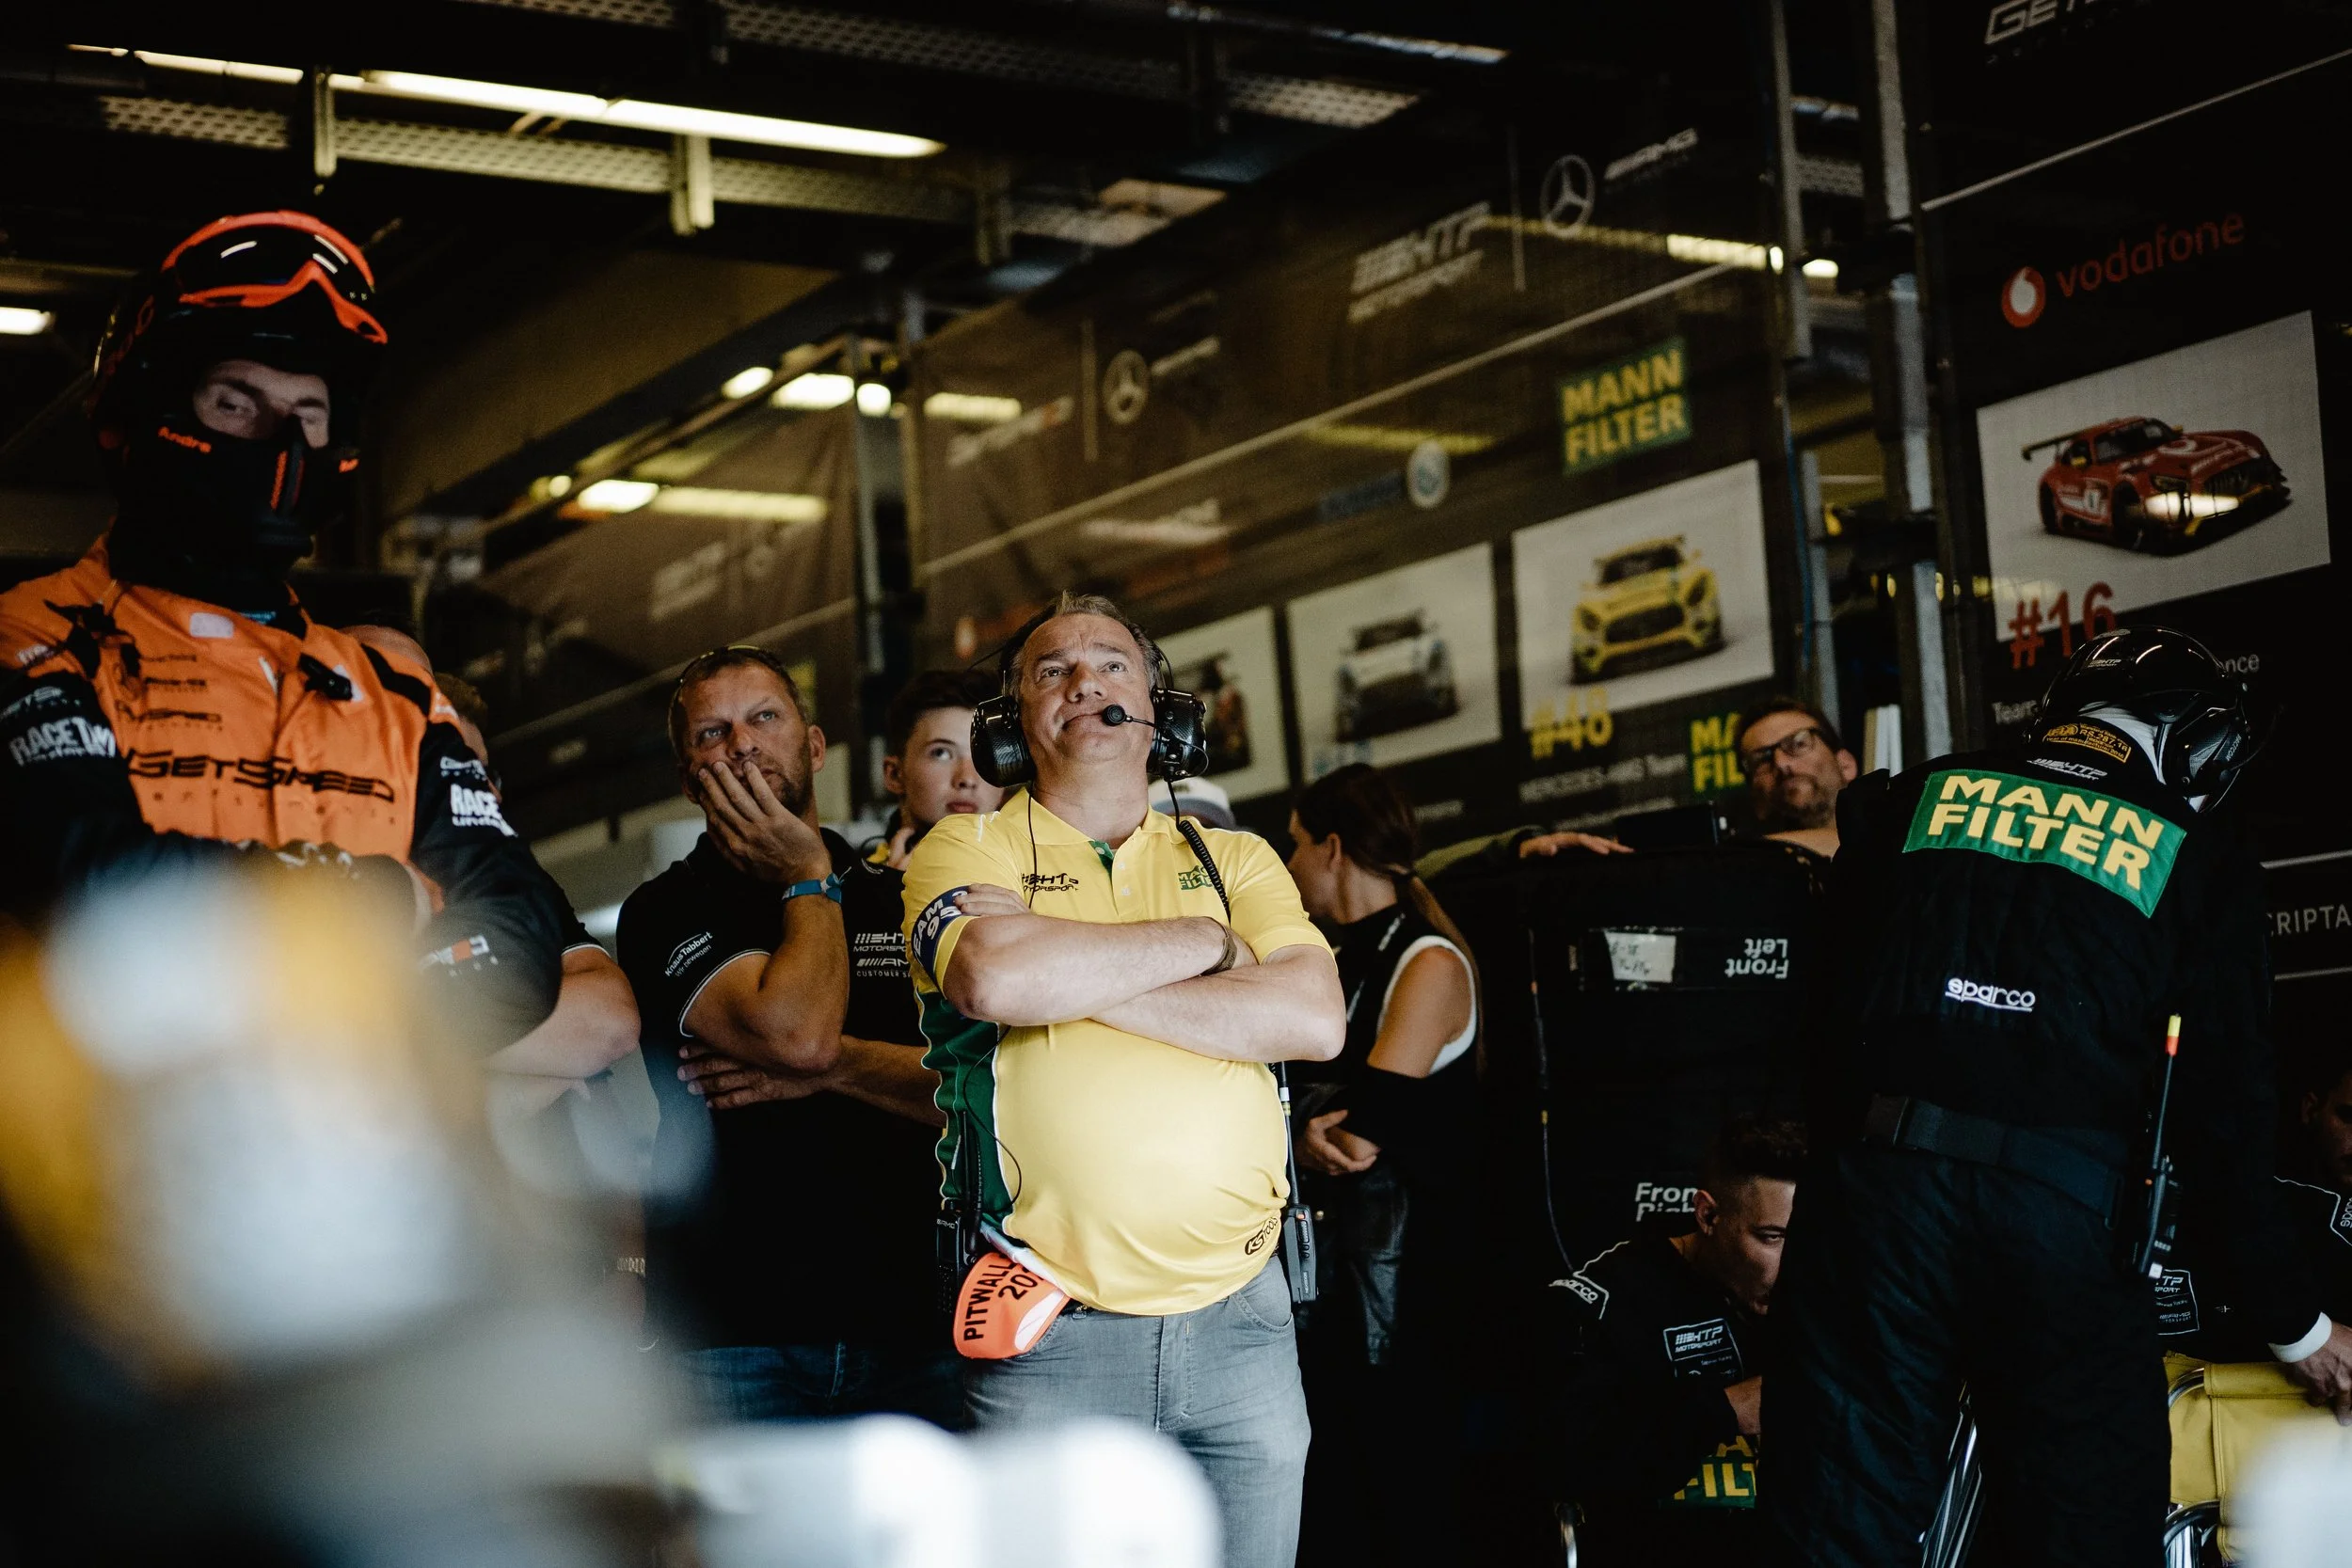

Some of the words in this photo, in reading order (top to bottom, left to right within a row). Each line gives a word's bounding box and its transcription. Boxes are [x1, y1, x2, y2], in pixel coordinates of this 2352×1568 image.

[2056, 213, 2246, 297] vodafone
[1563, 349, 1682, 423] MANN
[1565, 393, 1687, 467] FILTER
[2009, 582, 2116, 670] #16
[1940, 775, 2164, 850] MANN
[1928, 803, 2151, 891] FILTER
[913, 898, 944, 958] EAM
[2265, 903, 2352, 937] RIPTA
[1724, 958, 1789, 980] Front
[1744, 938, 1788, 958] Left
[856, 970, 899, 978] CUSTOMER
[1947, 977, 2036, 1009] sparco
[1247, 1230, 1264, 1254] KS
[998, 1267, 1044, 1300] 20
